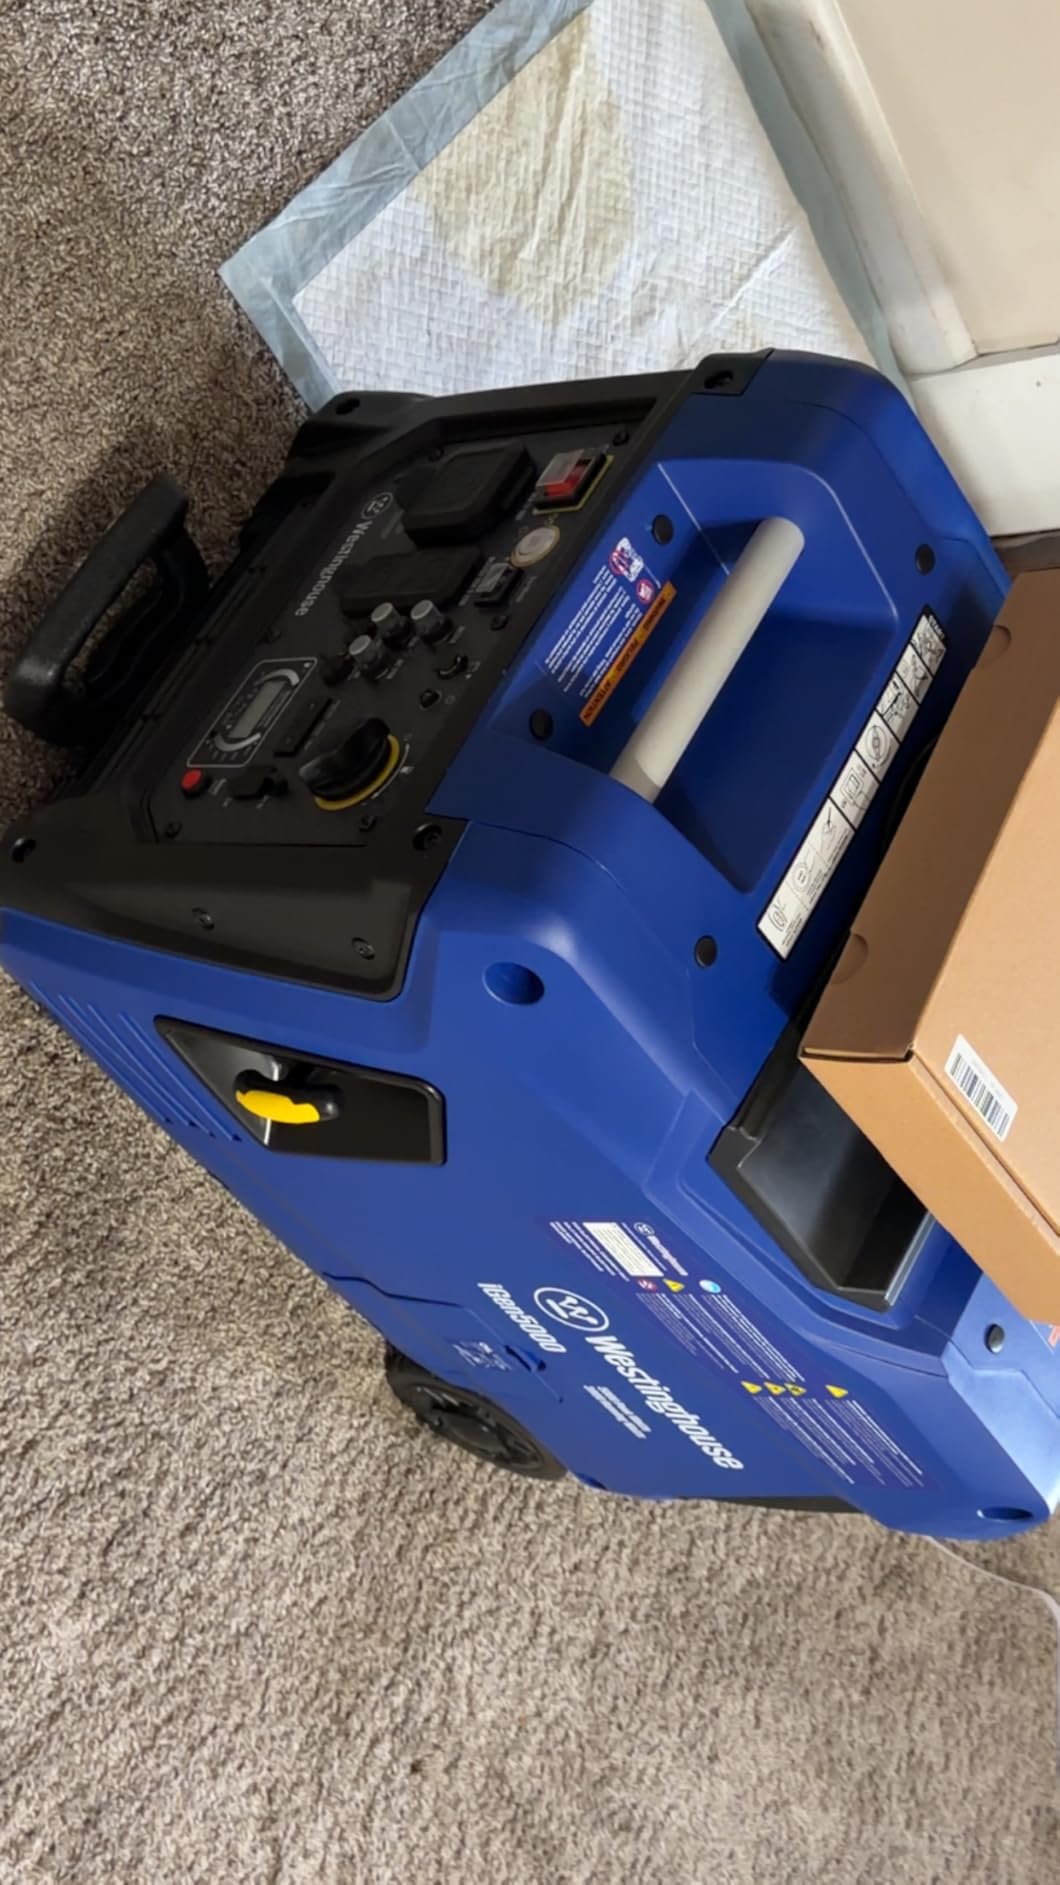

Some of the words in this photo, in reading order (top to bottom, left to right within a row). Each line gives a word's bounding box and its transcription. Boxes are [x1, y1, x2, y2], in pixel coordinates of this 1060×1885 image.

[295, 520, 374, 616] Westinghouse
[477, 1282, 567, 1353] iGen5000
[585, 1335, 744, 1470] Westinghouse
